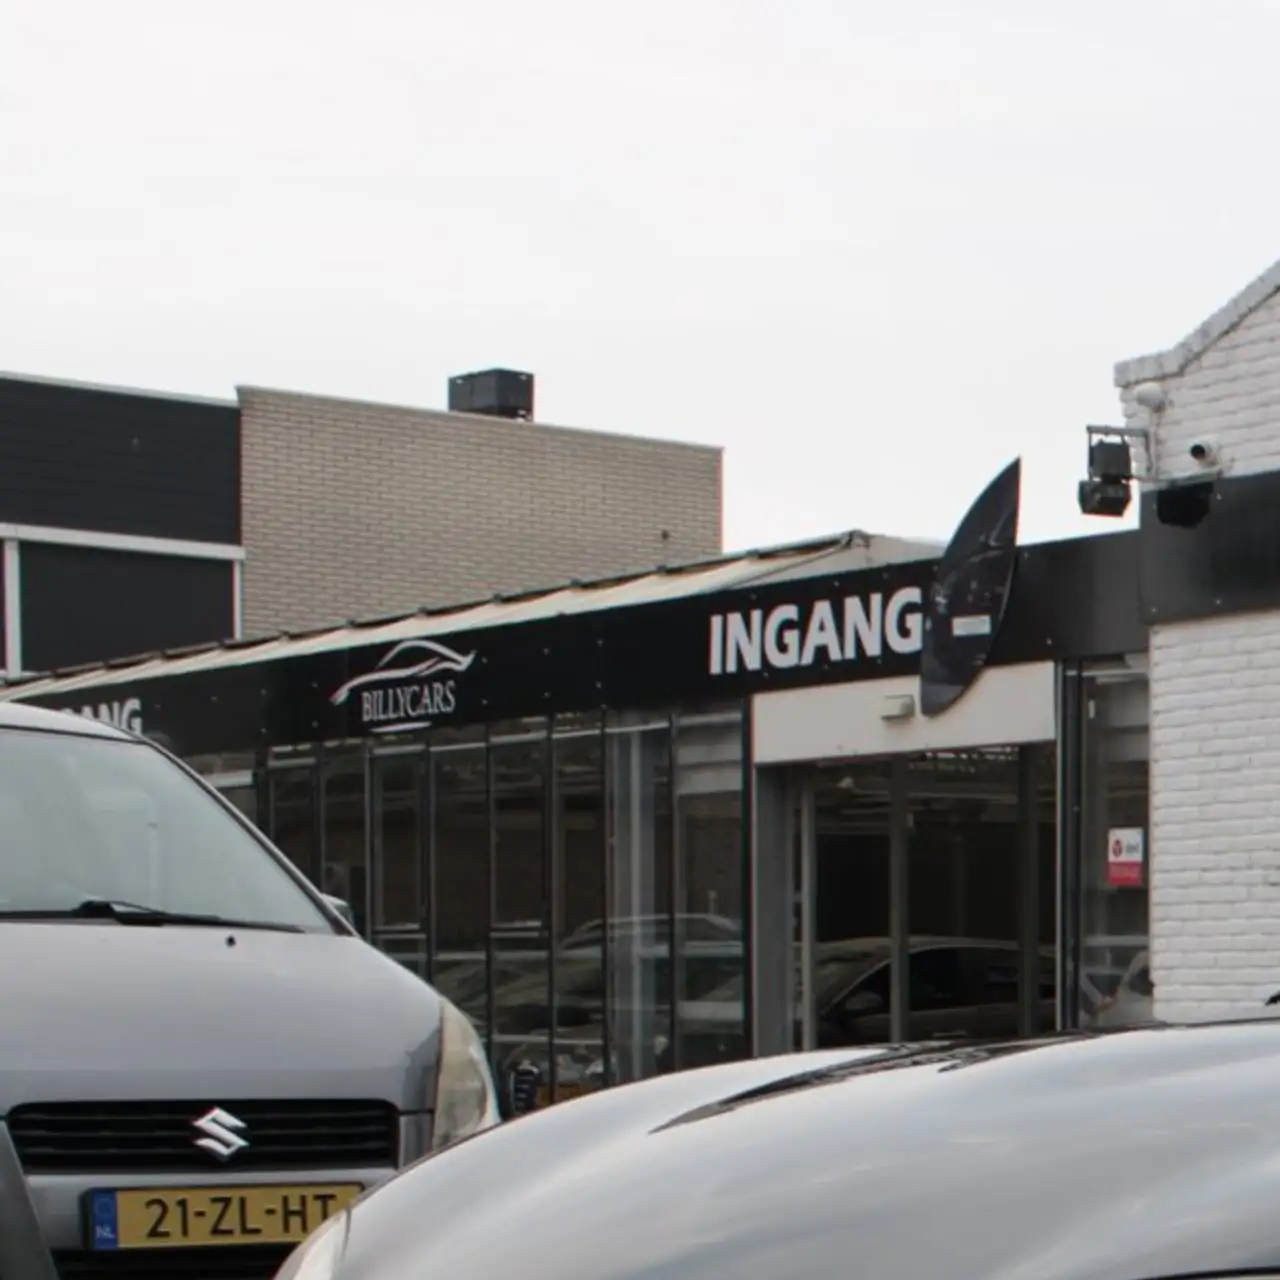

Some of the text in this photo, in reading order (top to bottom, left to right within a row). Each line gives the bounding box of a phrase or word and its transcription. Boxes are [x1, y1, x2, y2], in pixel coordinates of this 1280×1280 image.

[709, 587, 923, 674] INGANG
[362, 680, 456, 722] BILLYCARS
[145, 1194, 338, 1239] 21-ZL-HT
